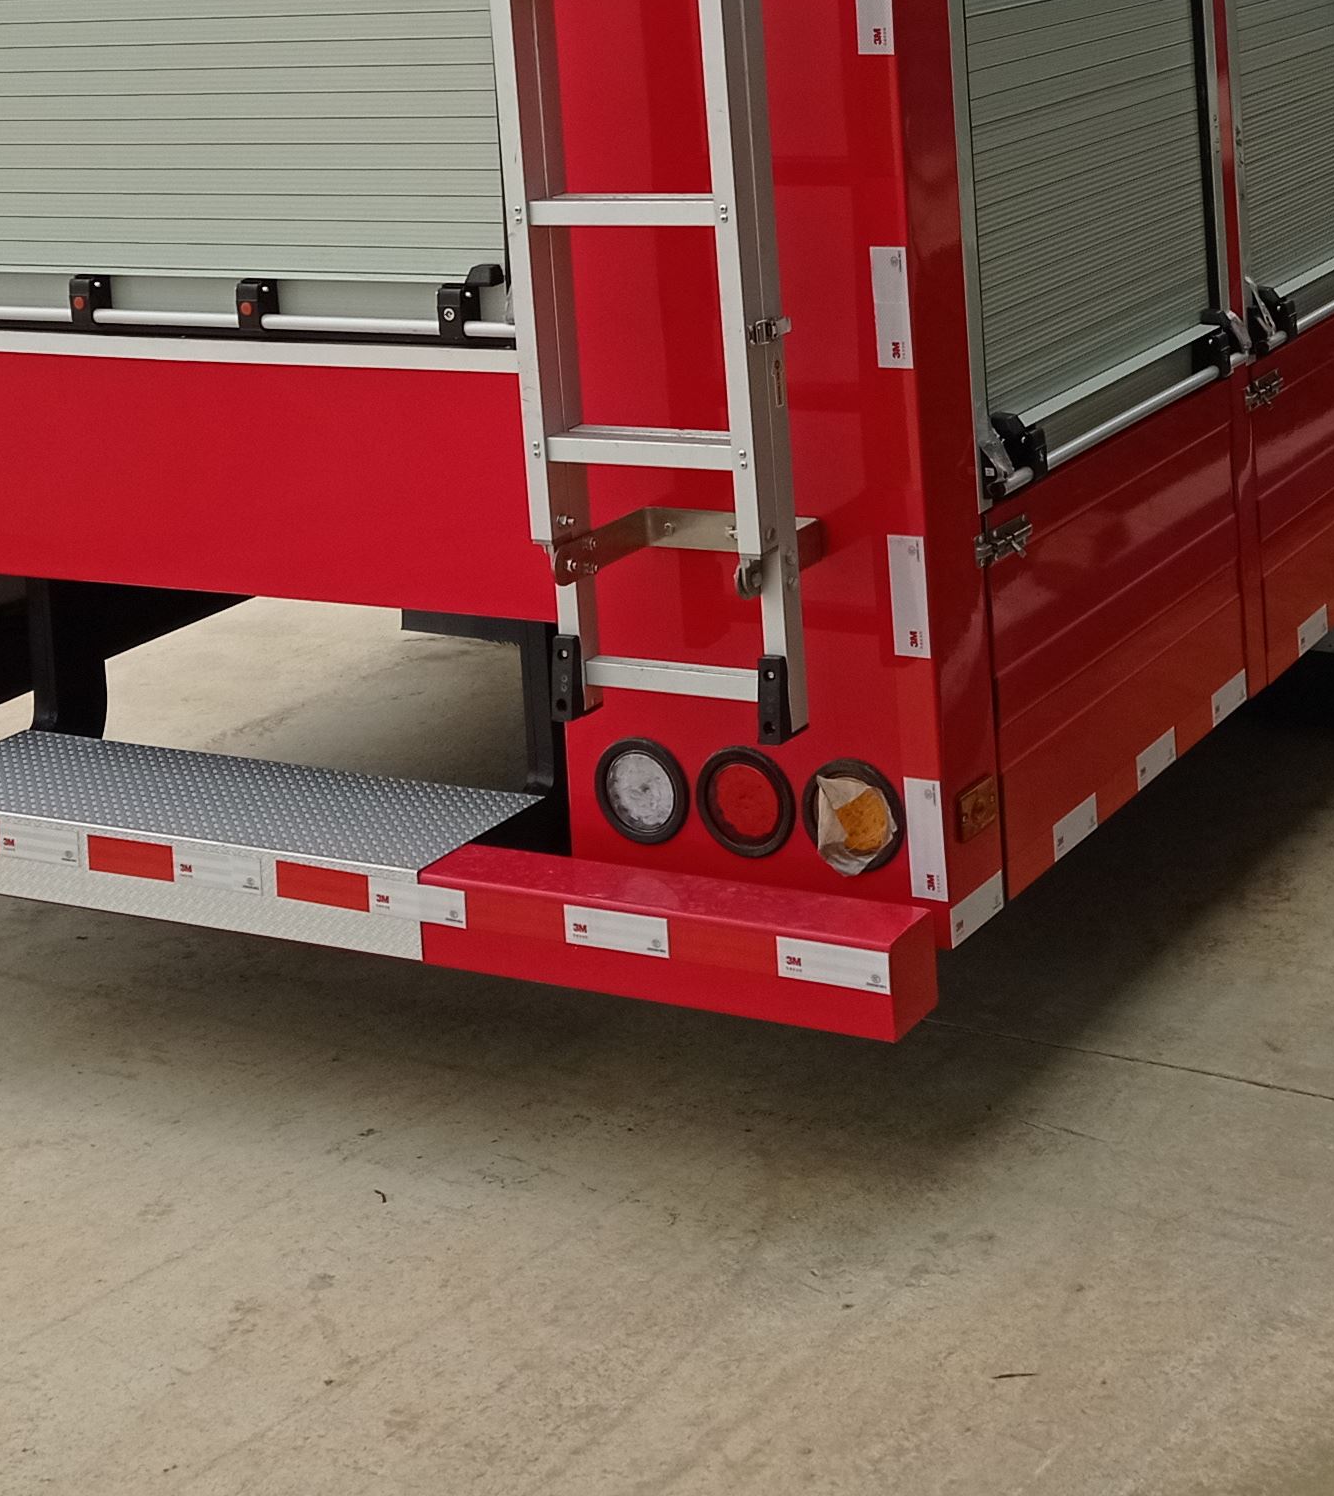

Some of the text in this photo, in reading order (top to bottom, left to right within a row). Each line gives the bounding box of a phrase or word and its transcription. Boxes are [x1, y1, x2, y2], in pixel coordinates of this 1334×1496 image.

[873, 28, 882, 45] 3M
[891, 342, 901, 359] 3M
[909, 631, 918, 648] 3M
[3, 837, 15, 847] 3M
[180, 863, 192, 873] 3M
[926, 874, 935, 891] 3M
[376, 893, 389, 904] 3M
[573, 923, 587, 934] 3M
[786, 955, 802, 967] 3M
